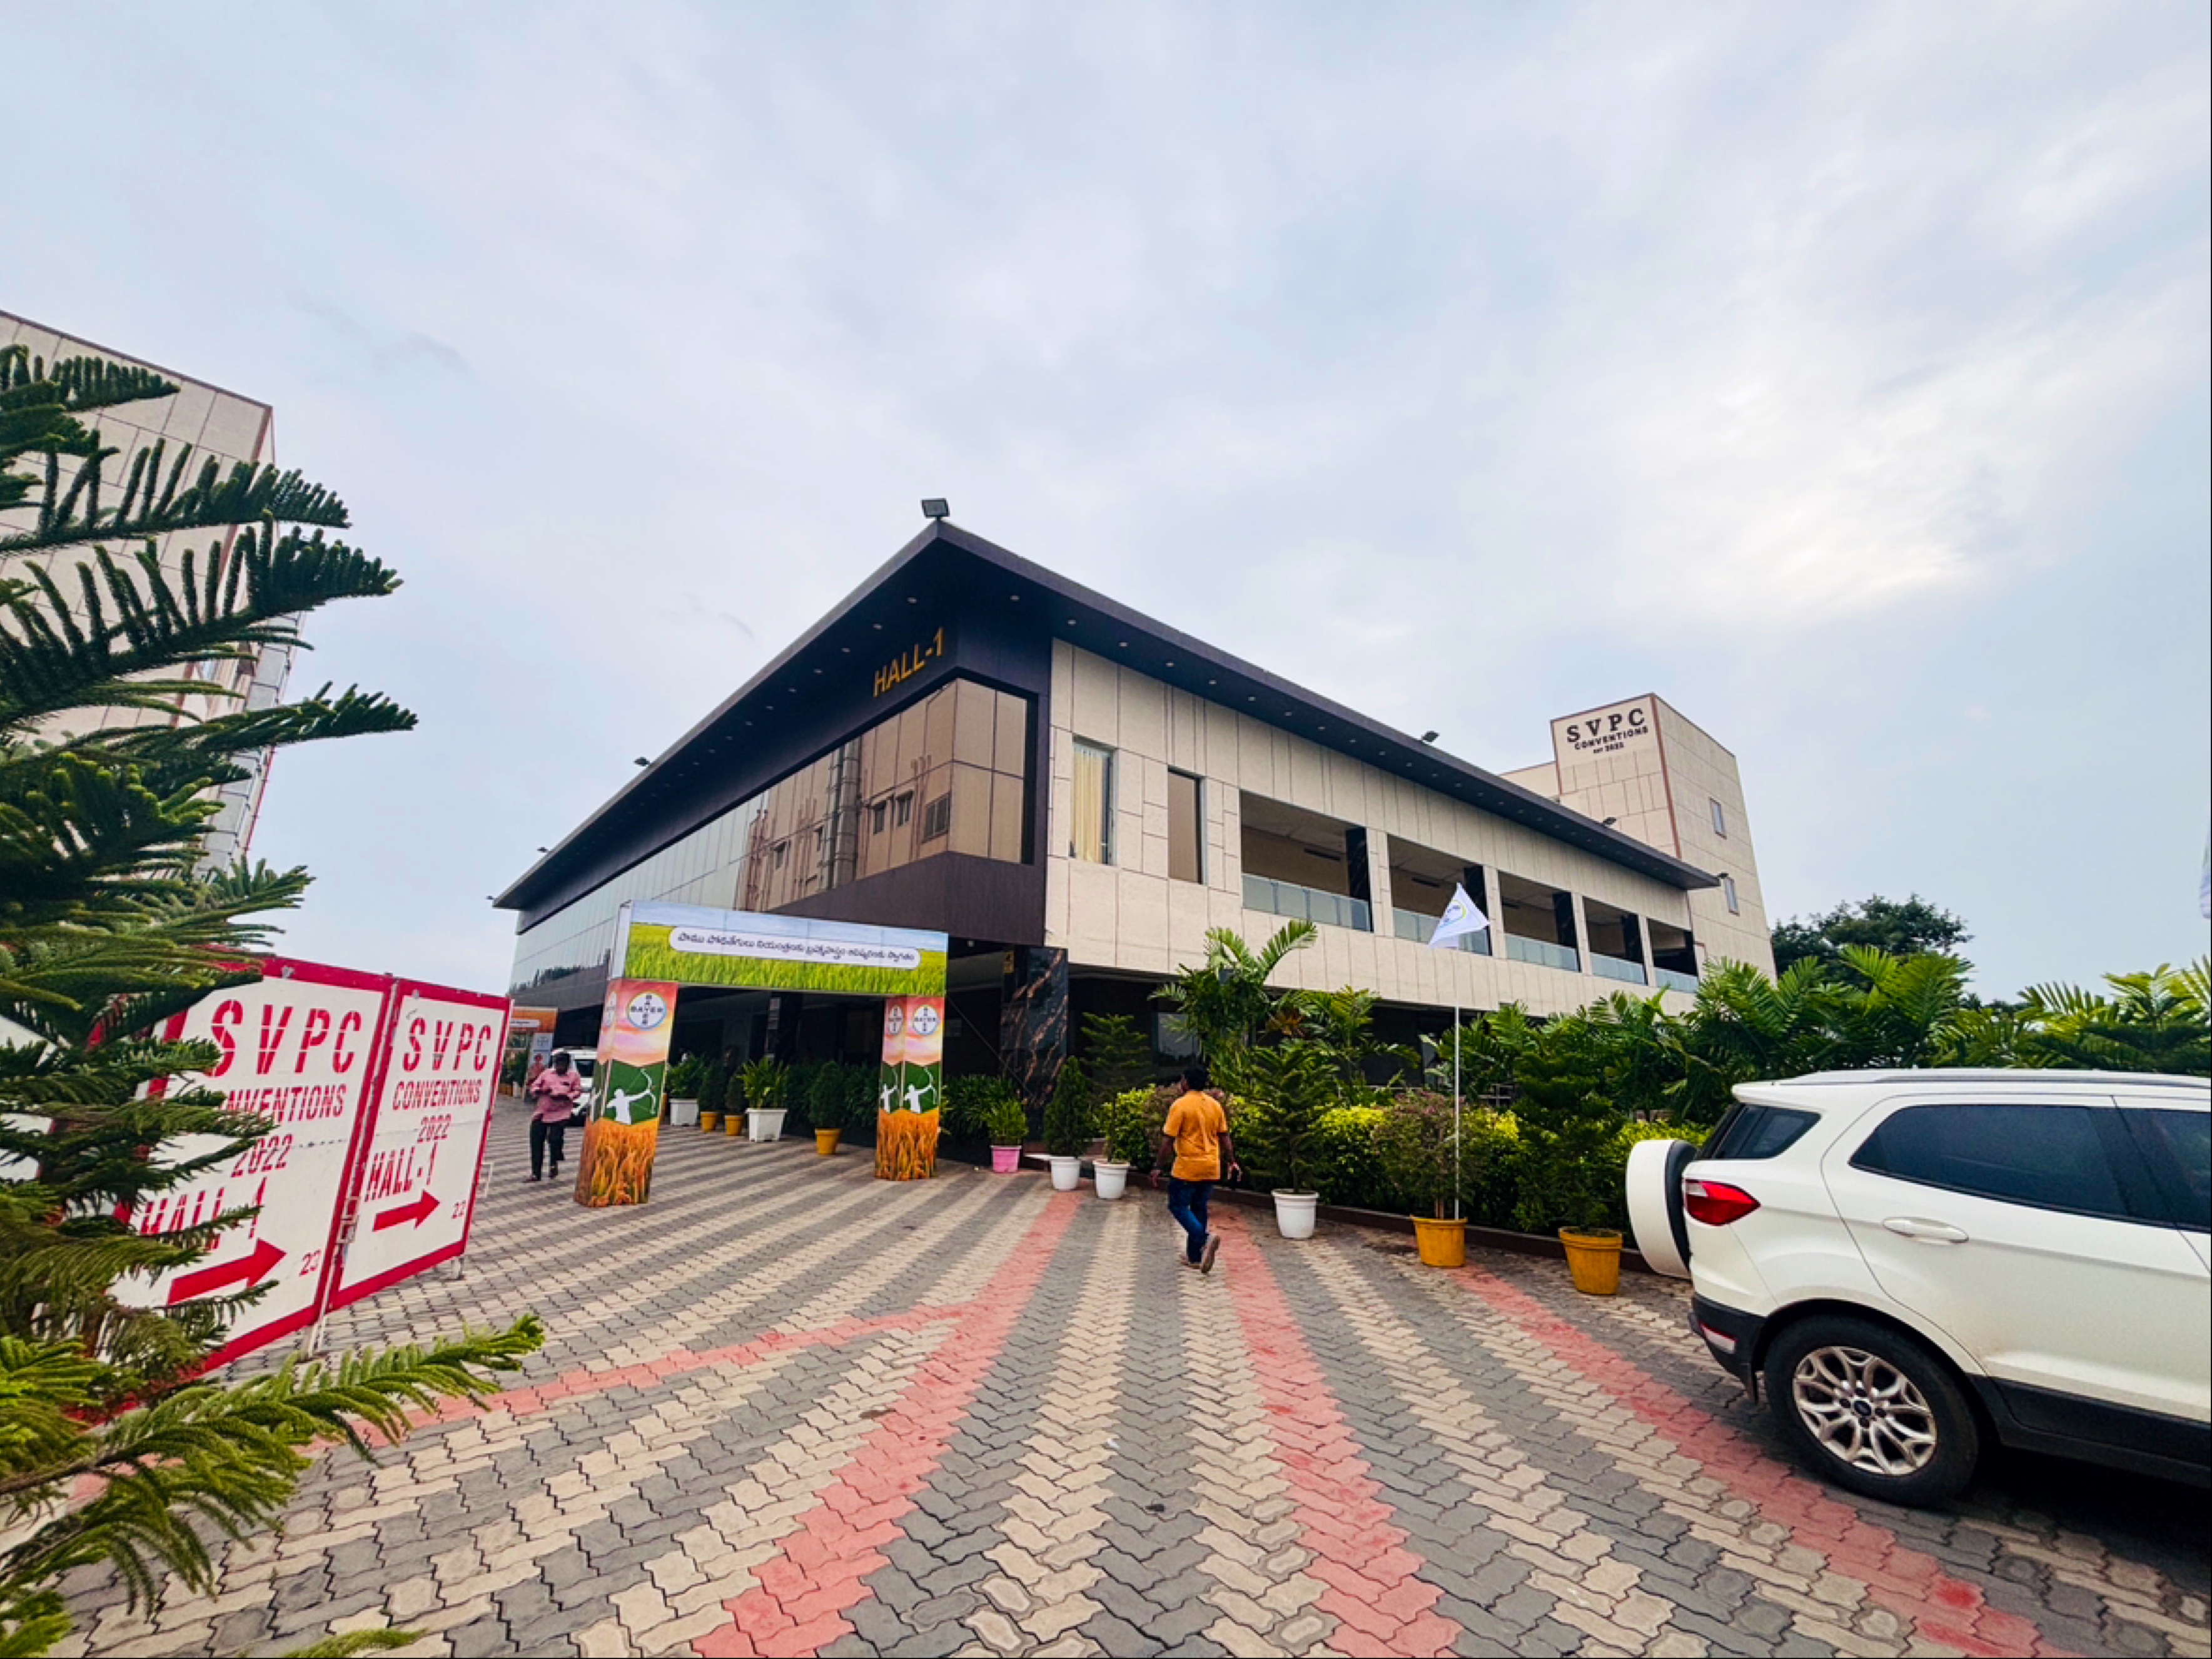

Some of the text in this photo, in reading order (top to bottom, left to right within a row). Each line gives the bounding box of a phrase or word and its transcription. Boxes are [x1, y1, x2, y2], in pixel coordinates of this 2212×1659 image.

[873, 627, 945, 698] HALL-1
[1574, 724, 1649, 751] CONVENTIONS
[205, 999, 363, 1078] SVPC
[403, 1017, 491, 1072] SVPC
[393, 1079, 483, 1110] CONVENTIONS
[417, 1113, 452, 1144] 2022
